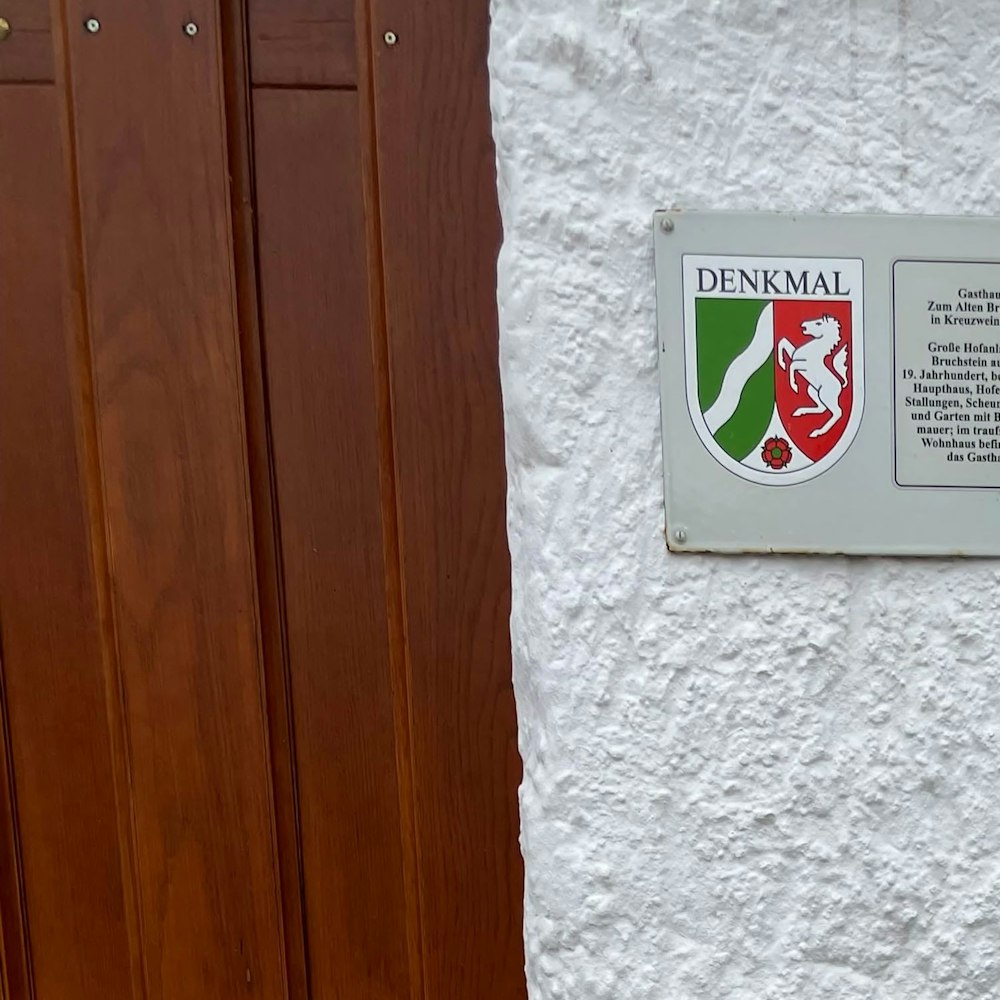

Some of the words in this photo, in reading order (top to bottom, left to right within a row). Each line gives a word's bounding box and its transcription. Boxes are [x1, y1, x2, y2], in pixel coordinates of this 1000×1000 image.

[696, 267, 851, 296] DENKMAL
[927, 301, 952, 312] Zum
[955, 302, 984, 313] Alten
[930, 314, 941, 325] in
[927, 342, 961, 353] Große
[932, 356, 987, 367] Bruchstein
[902, 369, 917, 380] 19.
[919, 370, 988, 382] Jahrhundert,
[913, 383, 973, 396] Haupthaus,
[905, 397, 963, 409] Stallungen,
[911, 411, 931, 421] und
[934, 411, 970, 422] Garten
[973, 412, 991, 422] mit
[917, 426, 953, 436] mauer;
[956, 425, 970, 435] im
[921, 438, 976, 449] Wohnhaus
[947, 452, 964, 462] das
